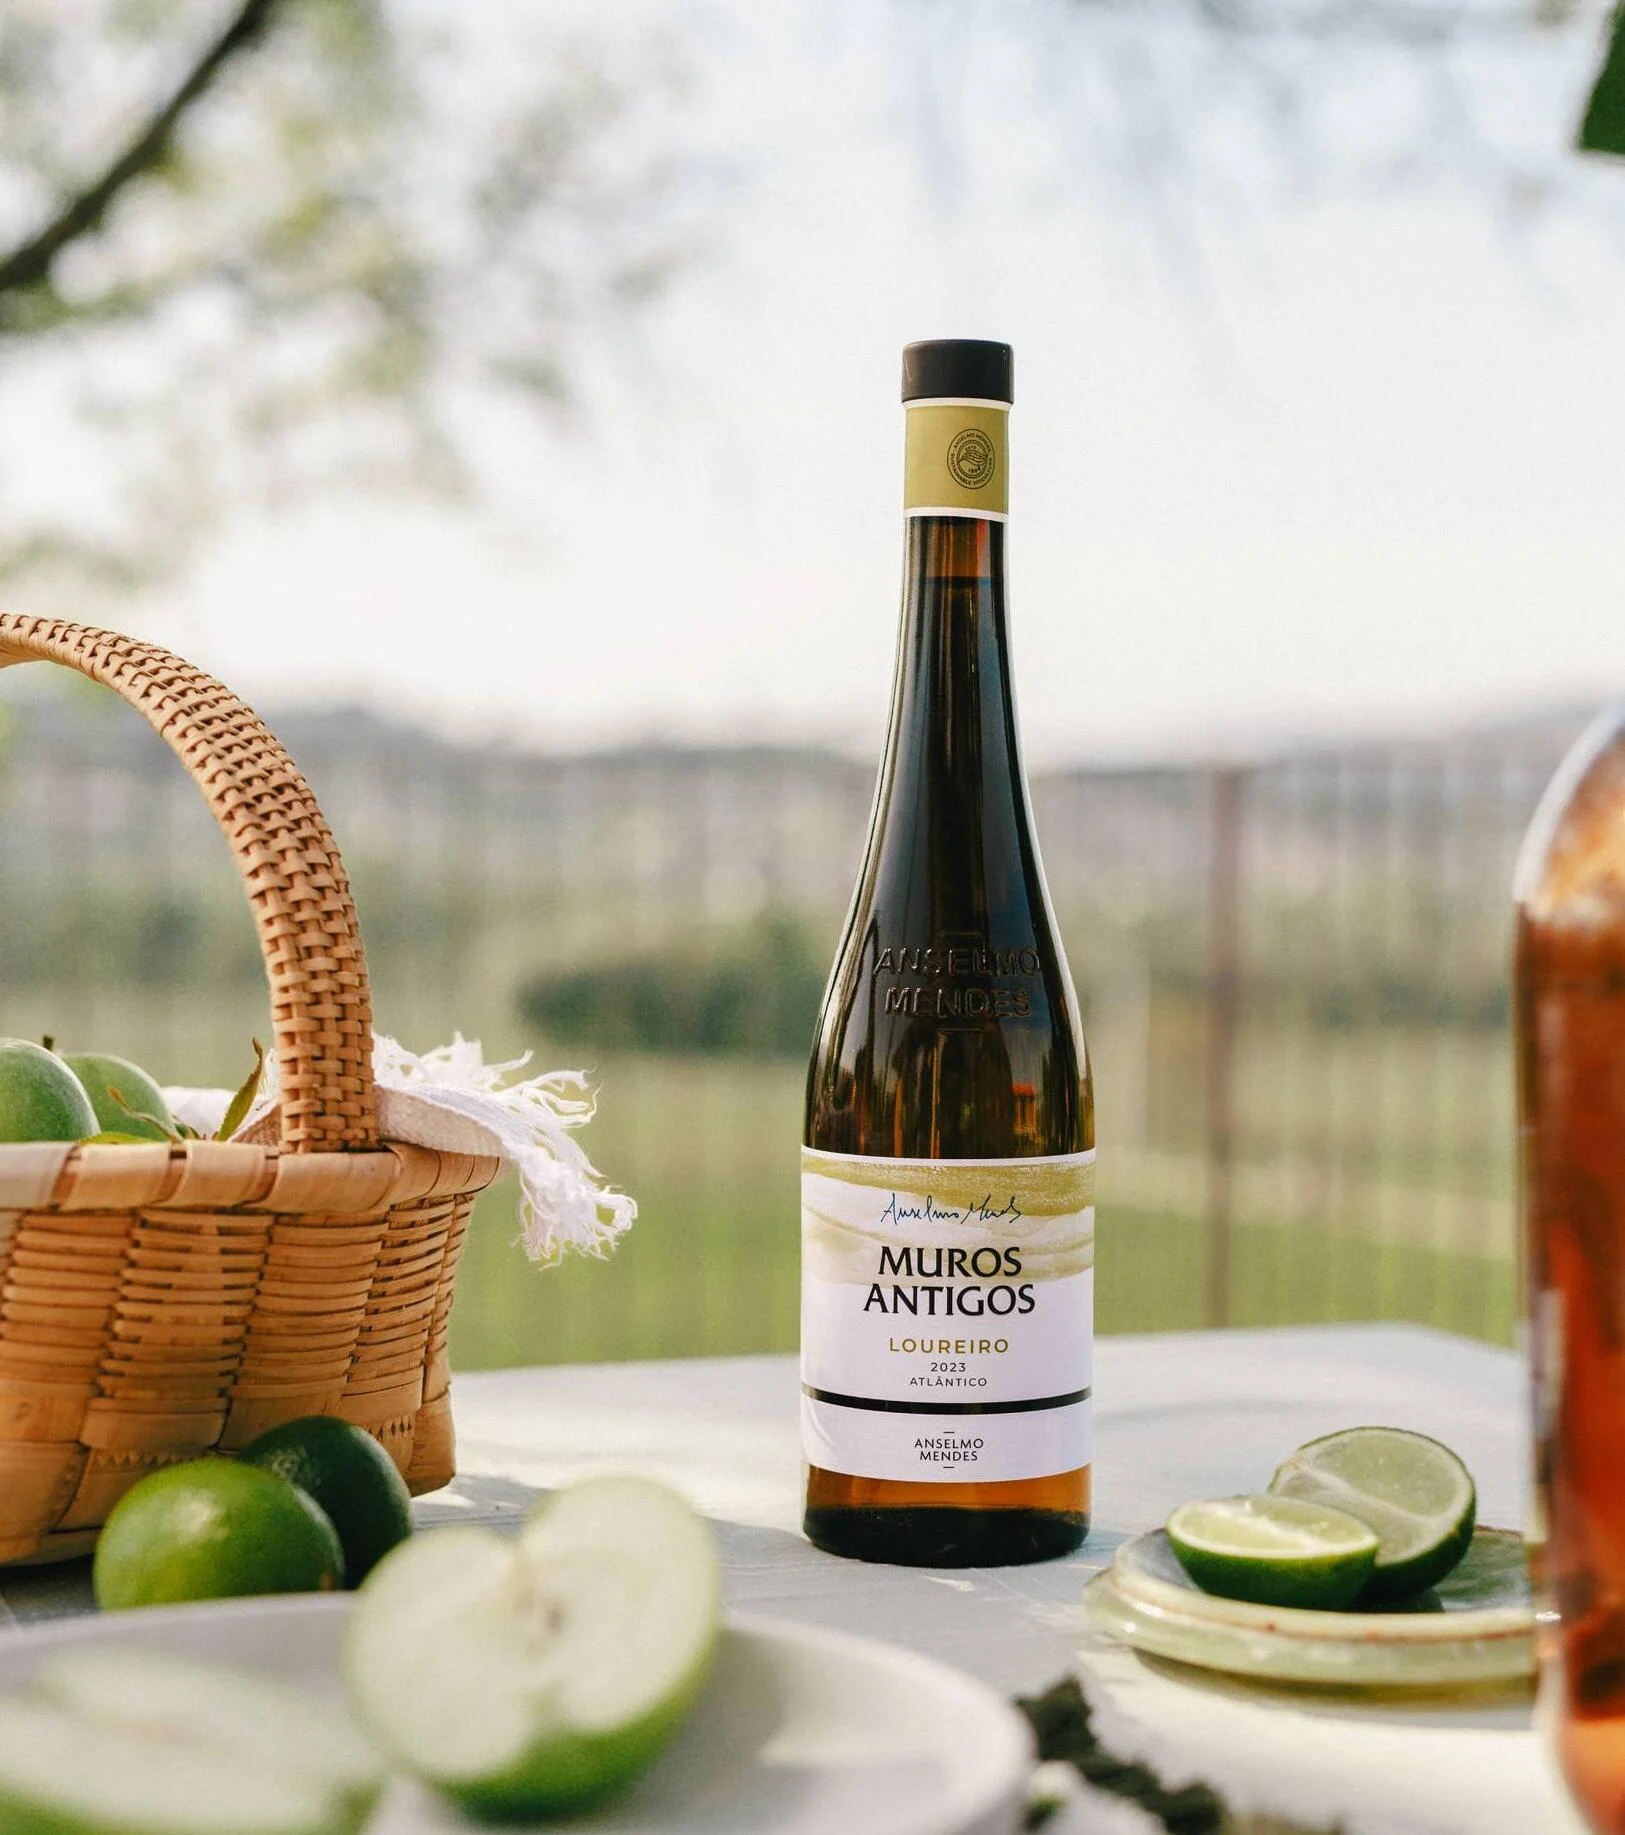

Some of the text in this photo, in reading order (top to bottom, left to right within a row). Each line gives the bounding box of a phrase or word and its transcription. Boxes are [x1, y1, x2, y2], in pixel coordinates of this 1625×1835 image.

[873, 948, 1040, 977] ANSELMO
[885, 987, 1032, 1018] MENDES
[878, 1246, 1022, 1278] MUROS
[863, 1283, 1036, 1316] ANTIGOS
[889, 1337, 1010, 1355] LOUREIRO
[930, 1362, 967, 1373] 2023
[909, 1375, 988, 1388] ATLÂNTICO
[914, 1438, 985, 1450] ANSELMO
[919, 1451, 979, 1462] MENDES
